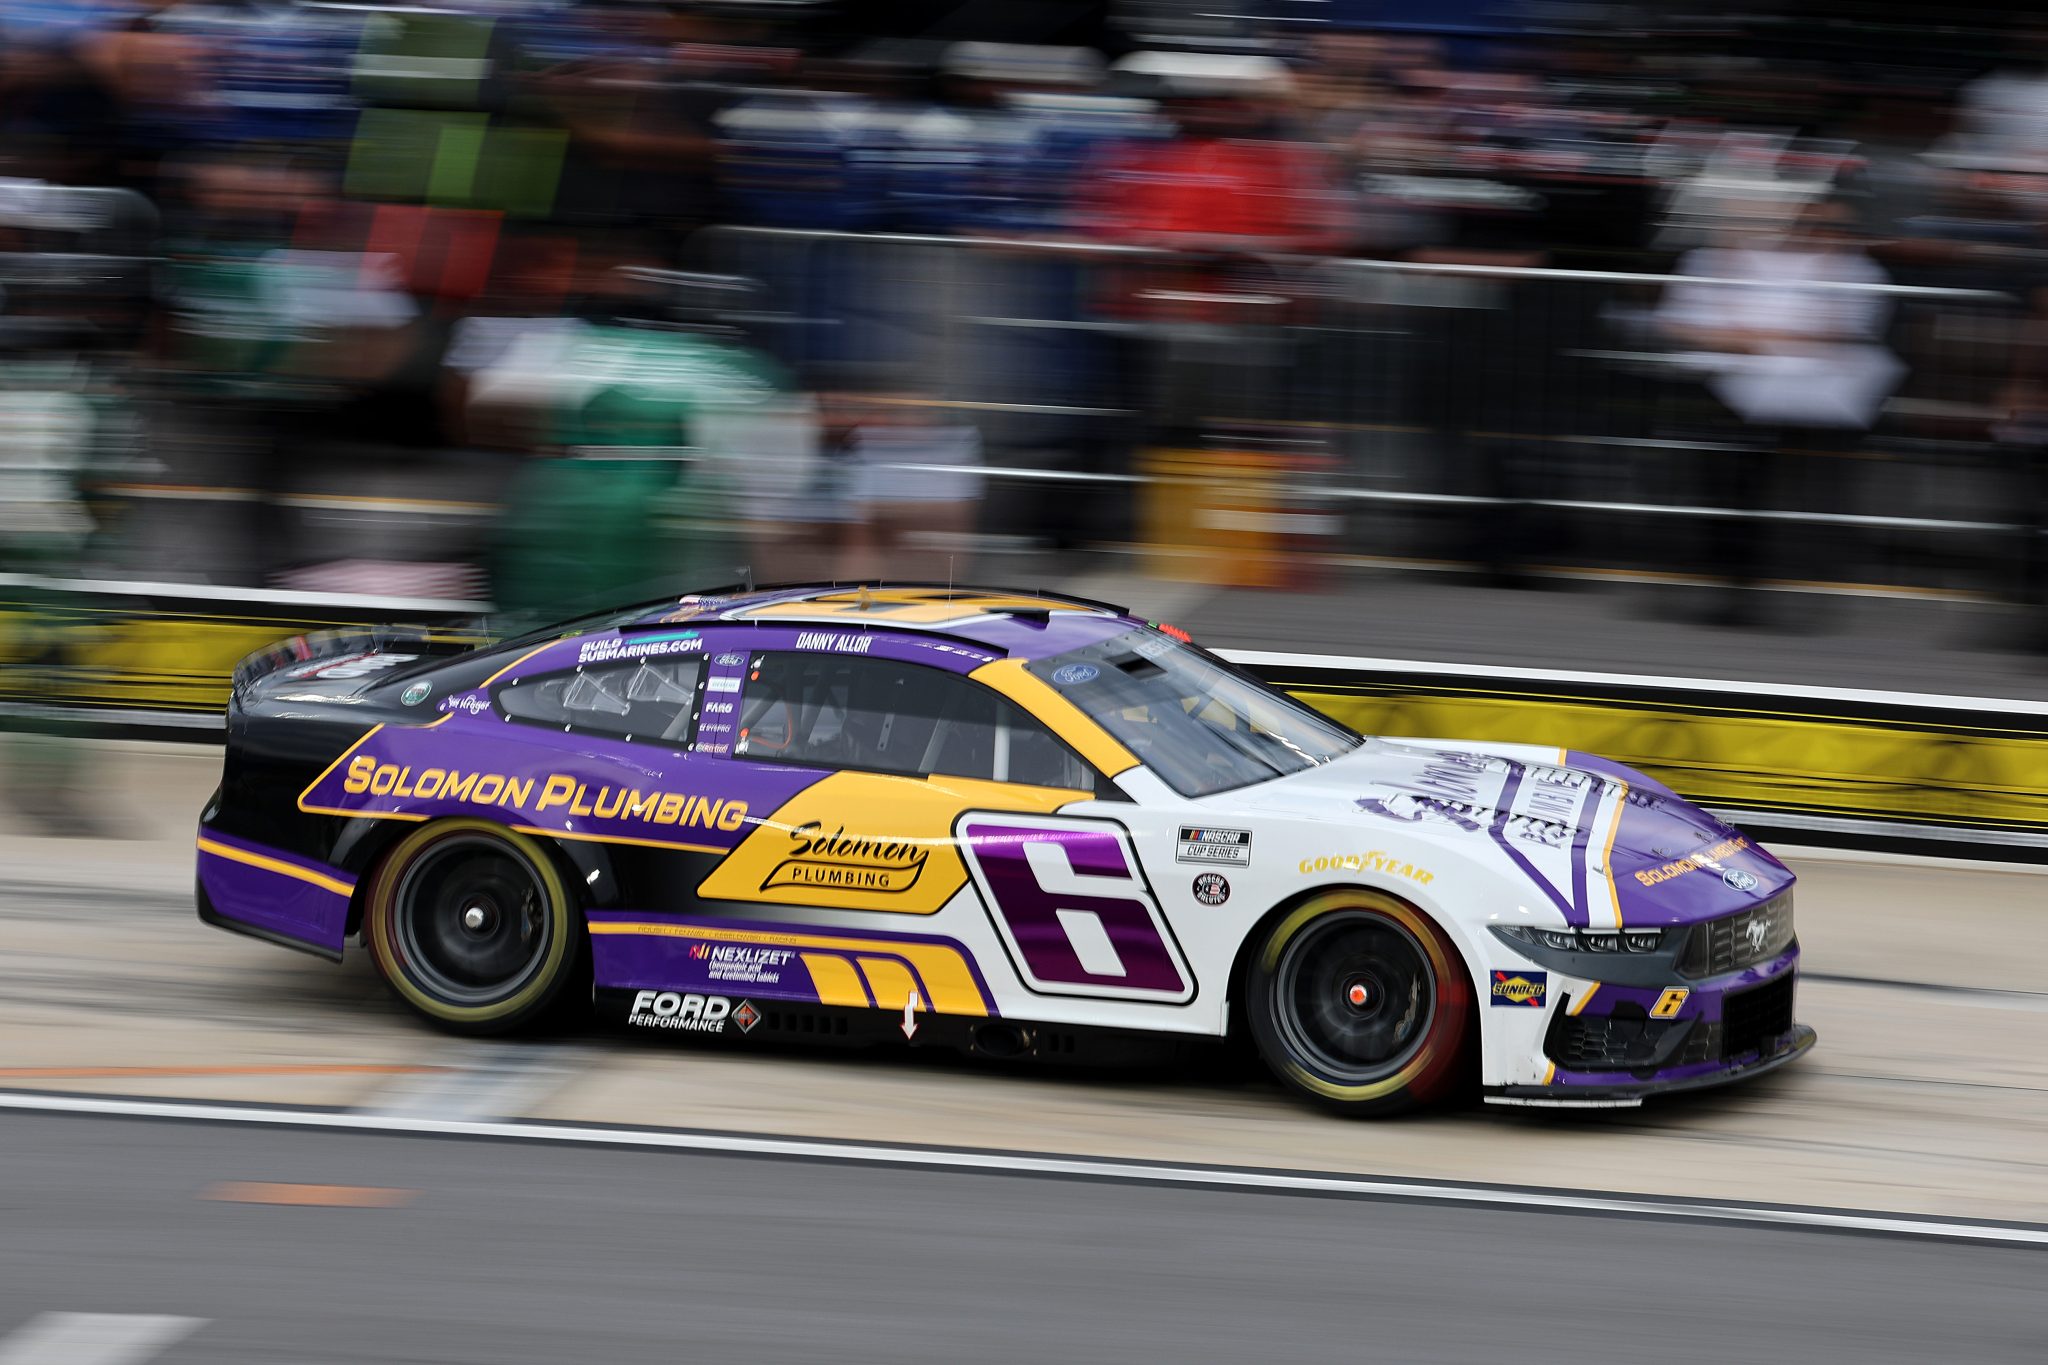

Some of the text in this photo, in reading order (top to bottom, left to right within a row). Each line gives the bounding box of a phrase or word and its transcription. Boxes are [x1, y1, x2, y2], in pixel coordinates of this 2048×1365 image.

[578, 638, 703, 663] SUBMARINES.COM
[581, 638, 622, 652] BUILD
[796, 632, 872, 653] DANNY ALLOR
[343, 755, 750, 831] SOLOMON PLUMBING
[789, 820, 929, 864] Solomon
[1202, 830, 1241, 844] NASCAR
[1187, 844, 1240, 858] CUP SERIES
[792, 867, 890, 888] PLUMBING
[1299, 849, 1434, 886] GOODYEAR
[962, 817, 1190, 997] 6
[1493, 982, 1545, 995] SUNOCO
[631, 989, 731, 1020] FORD
[1650, 988, 1689, 1018] 6
[628, 1013, 725, 1032] PERFORMANCE
